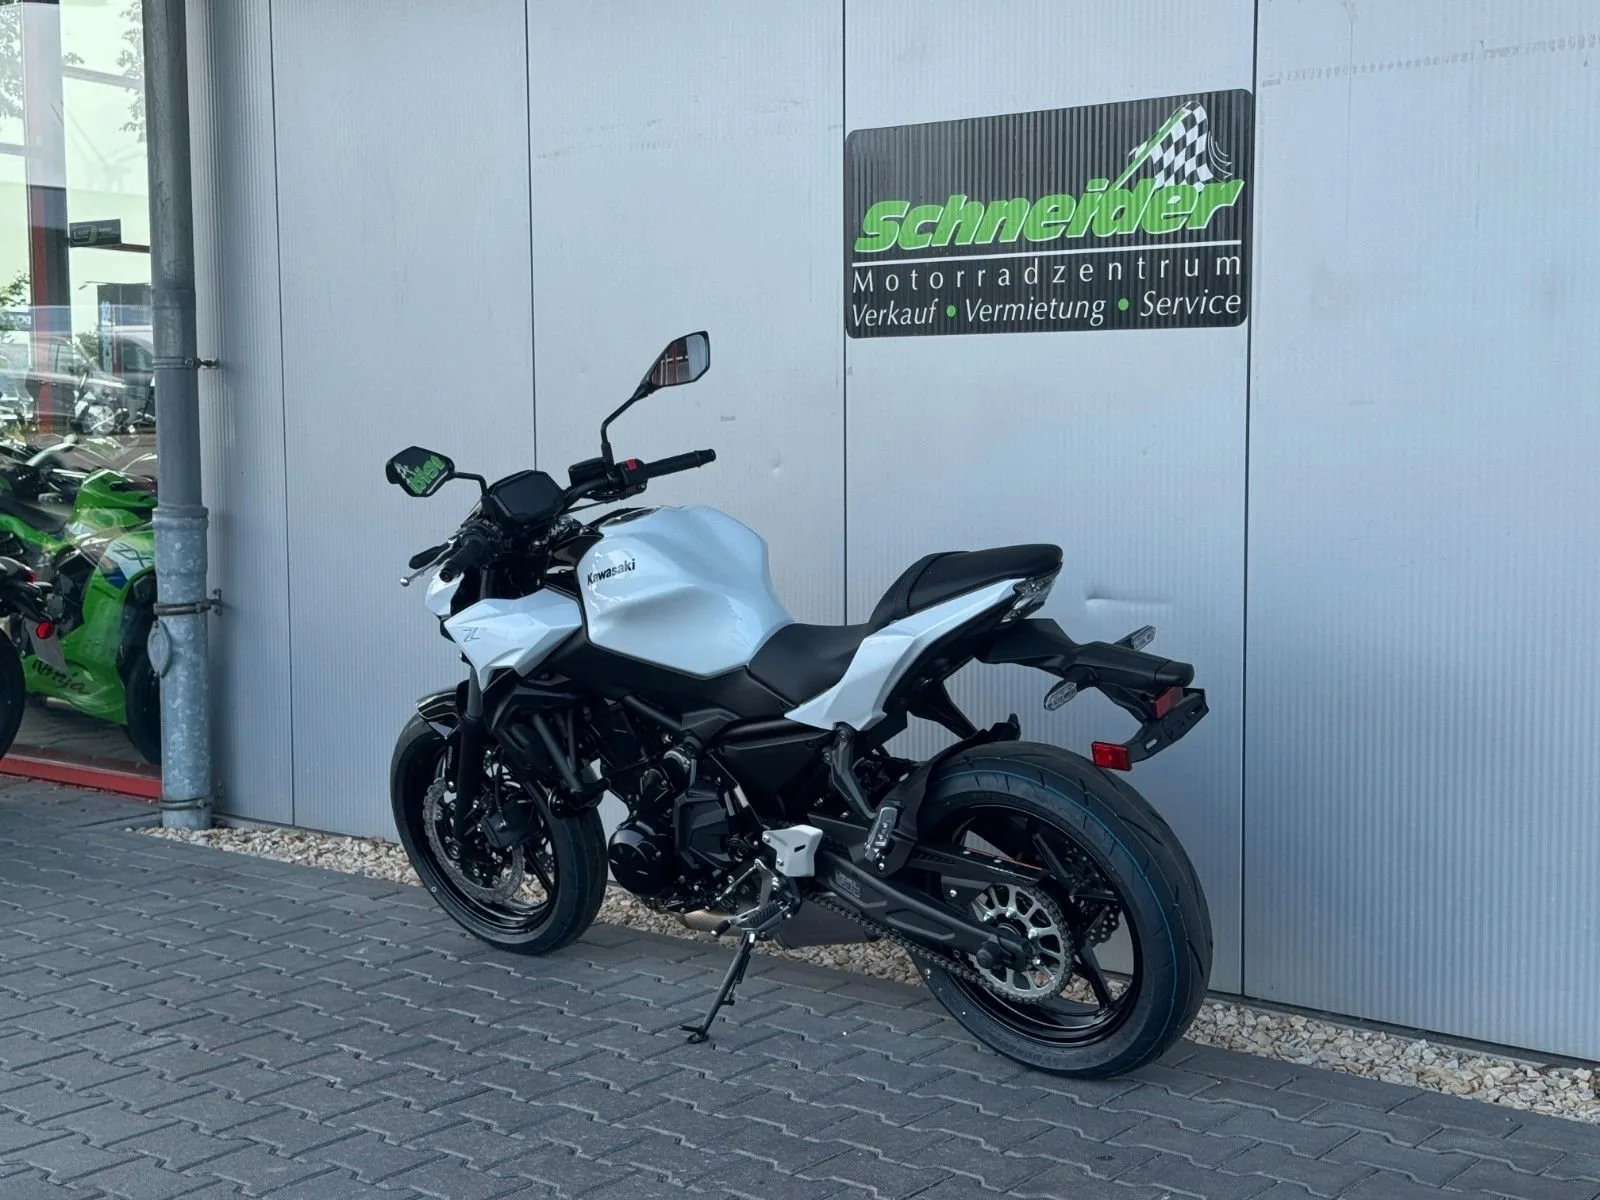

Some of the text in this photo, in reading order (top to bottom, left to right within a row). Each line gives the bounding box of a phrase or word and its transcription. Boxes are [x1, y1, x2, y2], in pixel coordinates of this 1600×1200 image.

[852, 255, 1241, 294] Motorradzentrum
[852, 288, 1242, 327] Verkauf Vermietung Service
[587, 557, 636, 586] Kawasaki
